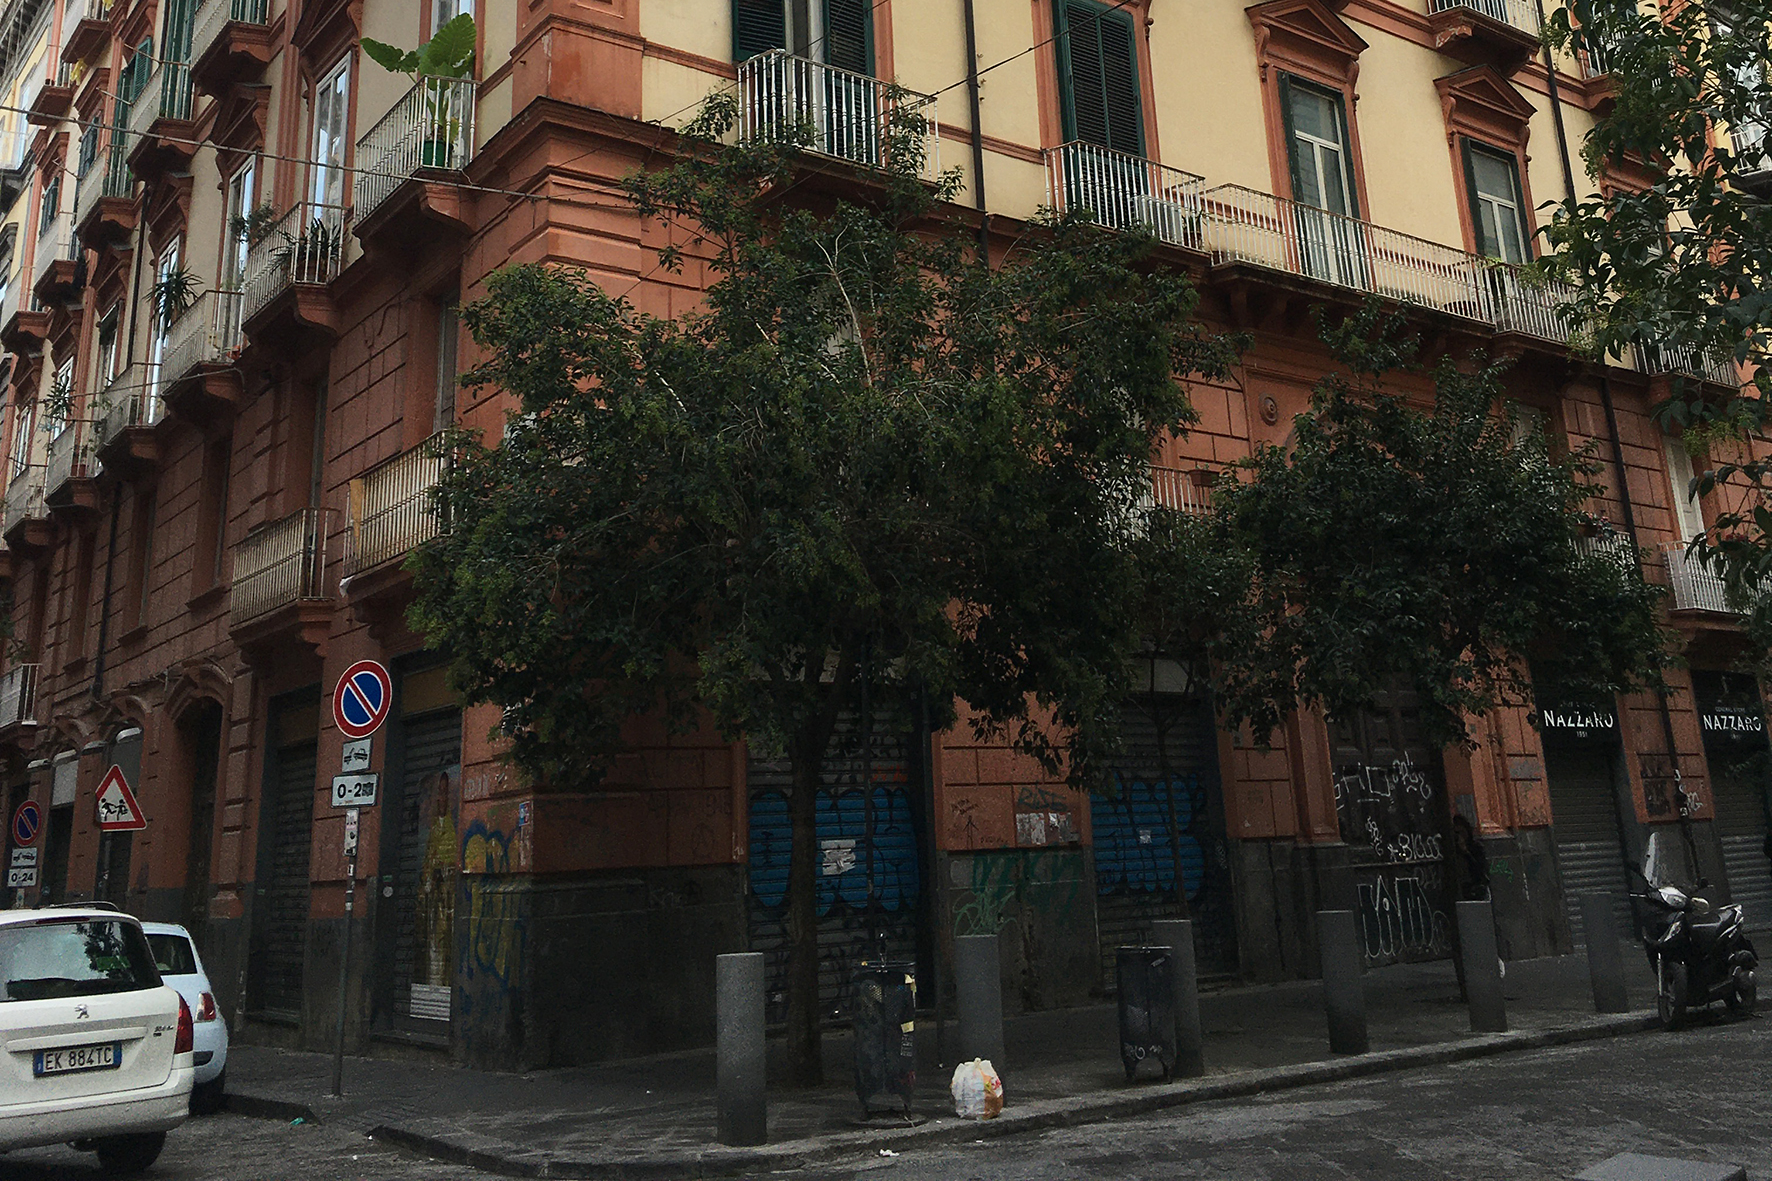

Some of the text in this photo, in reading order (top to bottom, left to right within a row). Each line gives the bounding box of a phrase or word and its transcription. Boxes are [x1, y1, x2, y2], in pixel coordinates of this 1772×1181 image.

[1702, 714, 1762, 731] NAZZARO
[11, 872, 34, 882] 0-24
[45, 1051, 63, 1070] EK
